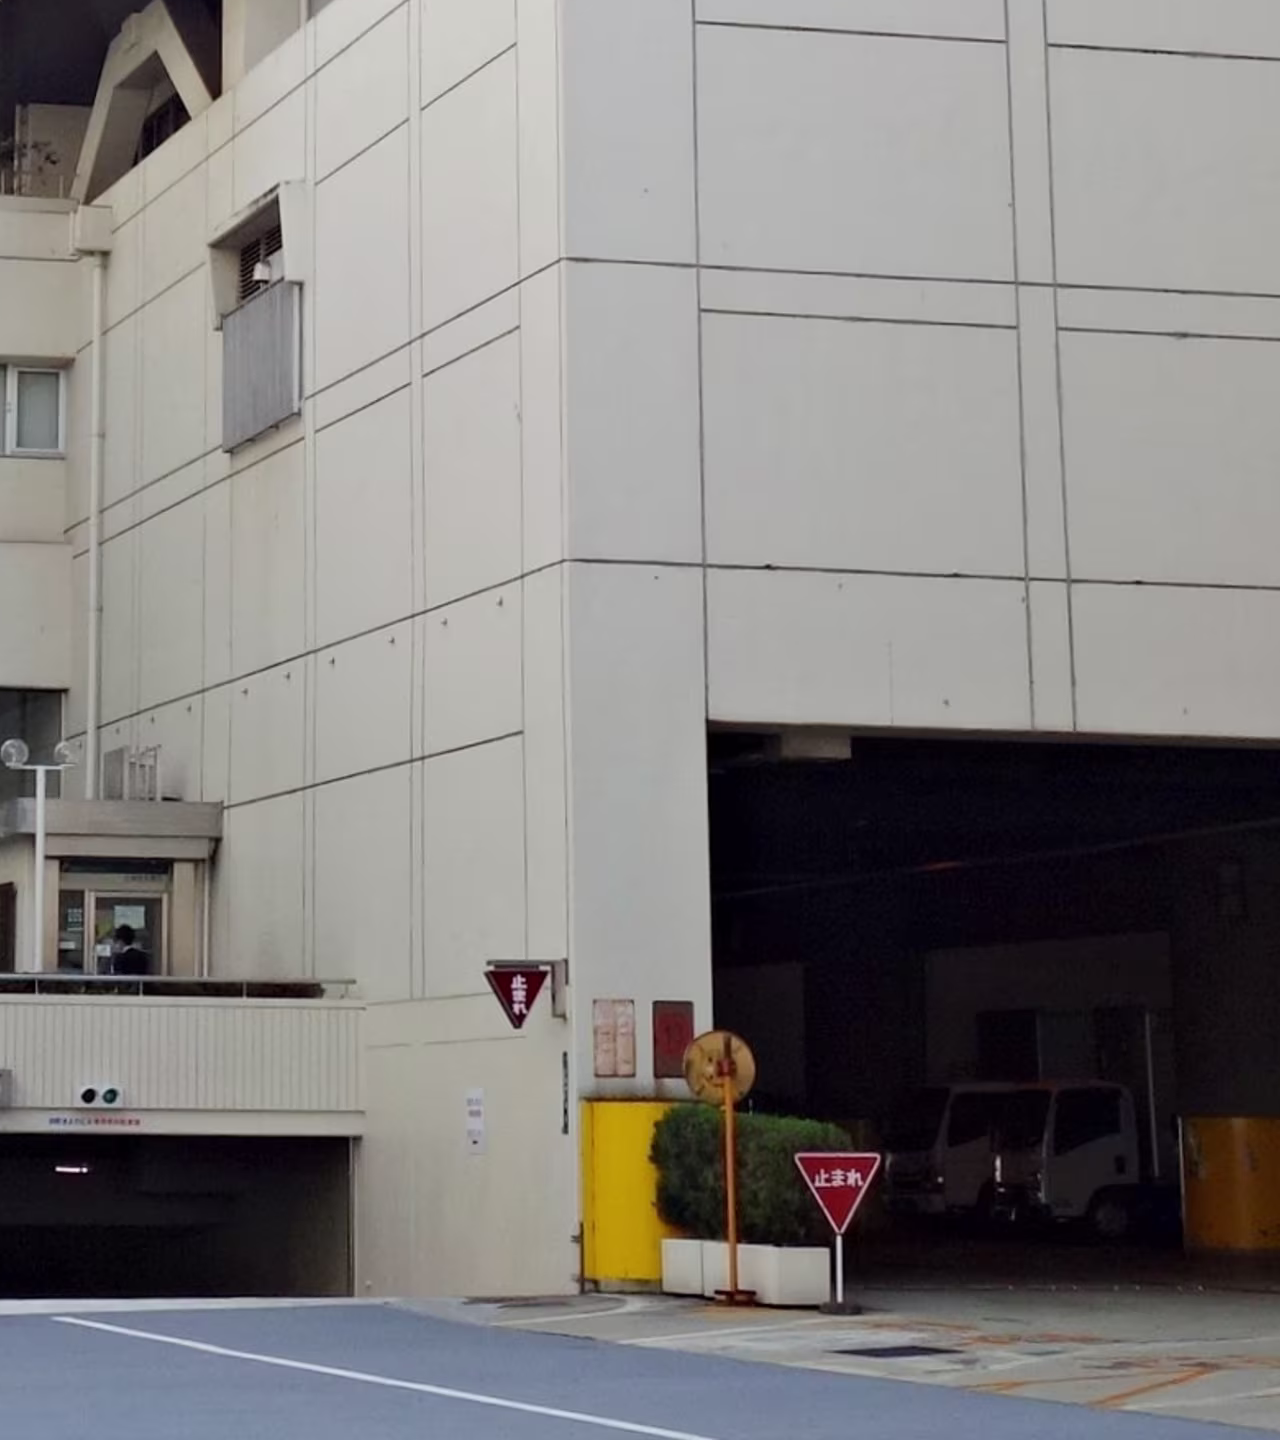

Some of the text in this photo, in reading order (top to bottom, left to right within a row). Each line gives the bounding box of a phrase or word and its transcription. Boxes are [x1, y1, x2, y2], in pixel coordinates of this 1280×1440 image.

[510, 973, 528, 1016] 止まれ
[813, 1167, 864, 1189] 止まれ
